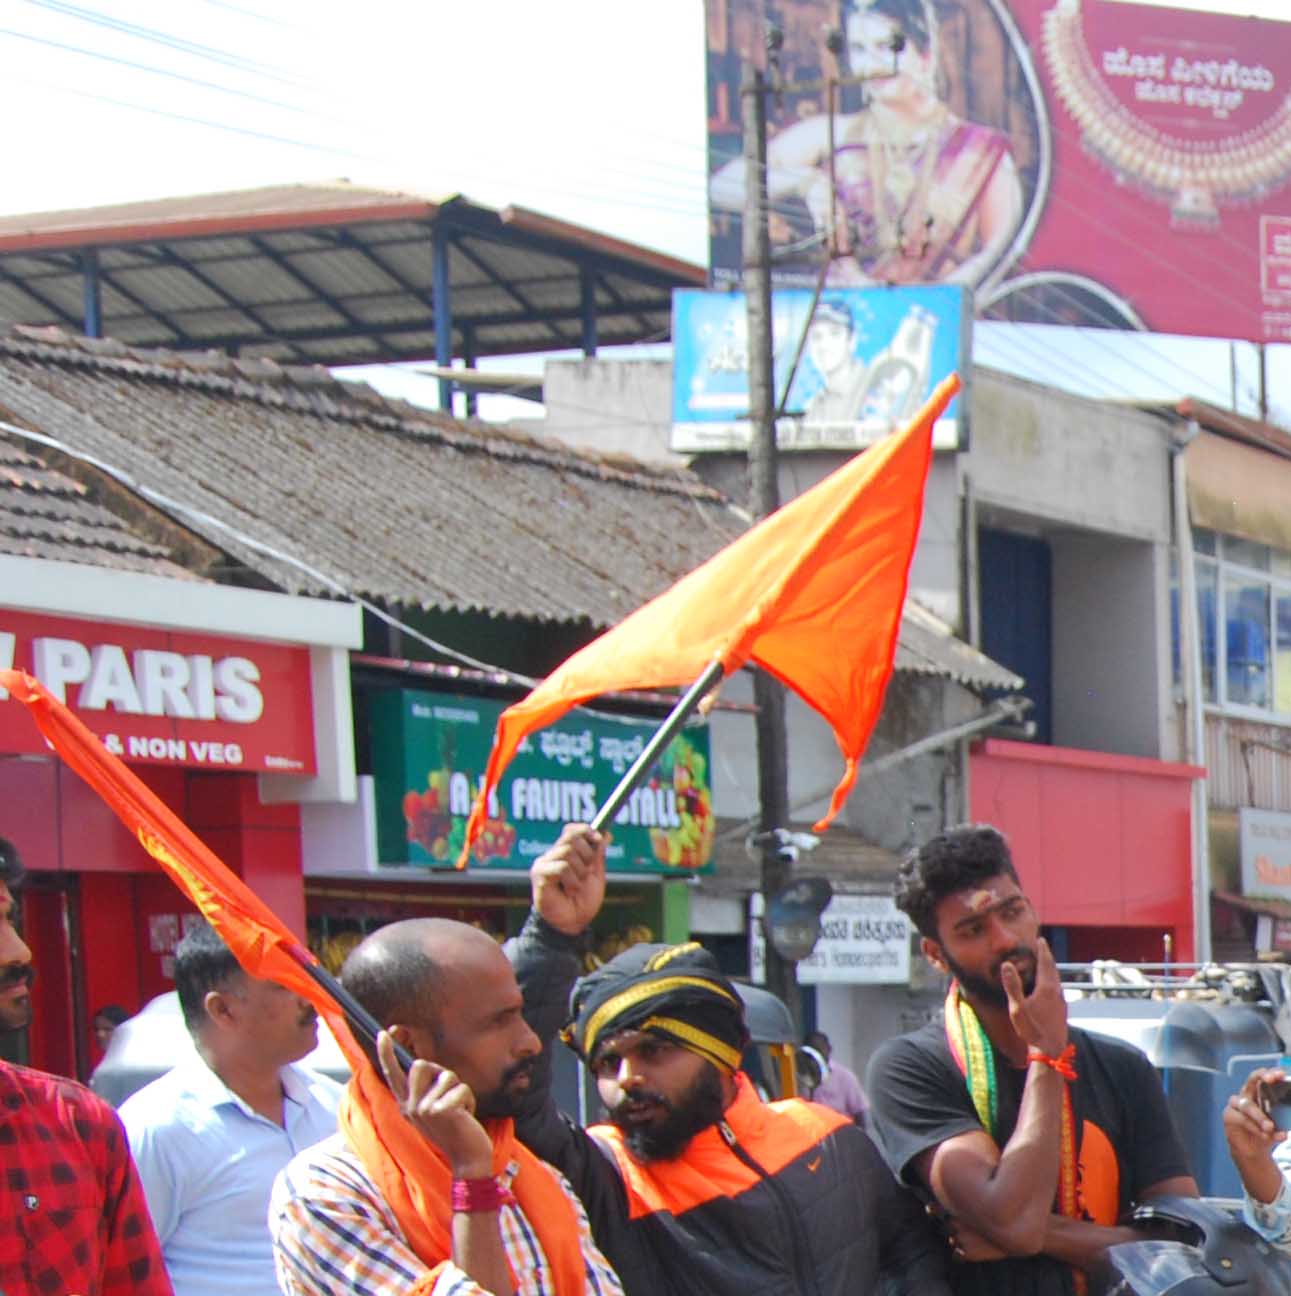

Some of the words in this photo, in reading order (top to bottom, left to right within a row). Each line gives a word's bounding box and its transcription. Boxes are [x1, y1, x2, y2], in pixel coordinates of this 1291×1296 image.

[32, 637, 264, 723] PARIS
[127, 736, 186, 760] NON
[189, 743, 243, 765] VEG
[511, 778, 597, 822] FRUITS
